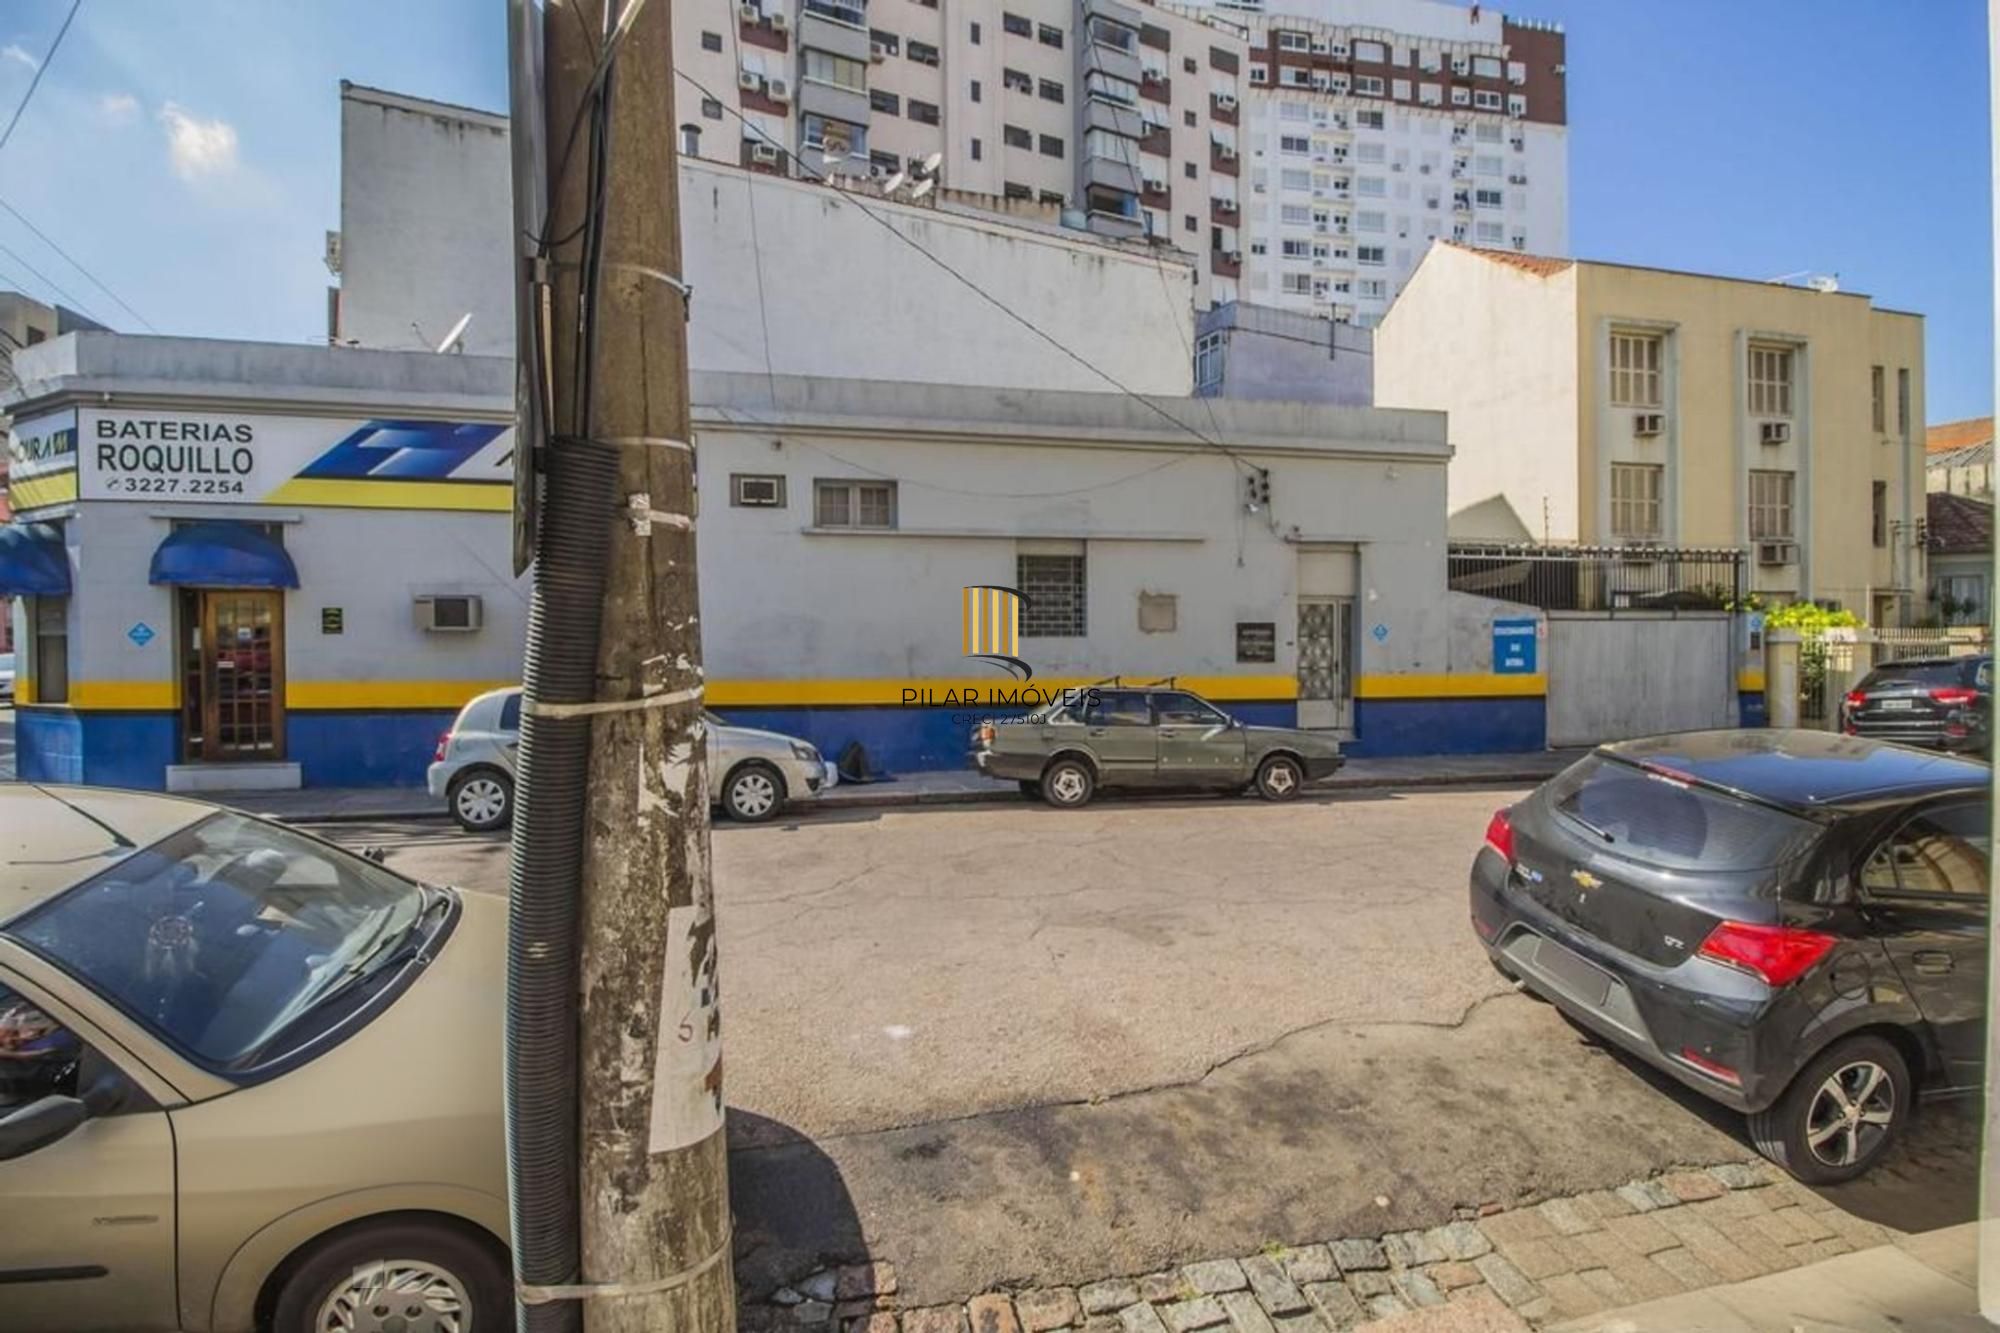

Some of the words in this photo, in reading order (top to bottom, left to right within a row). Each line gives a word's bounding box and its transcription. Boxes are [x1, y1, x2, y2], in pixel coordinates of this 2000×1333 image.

[97, 420, 253, 443] BATERIAS
[97, 444, 254, 474] ROQUILLO
[125, 478, 244, 494] 3227.2254
